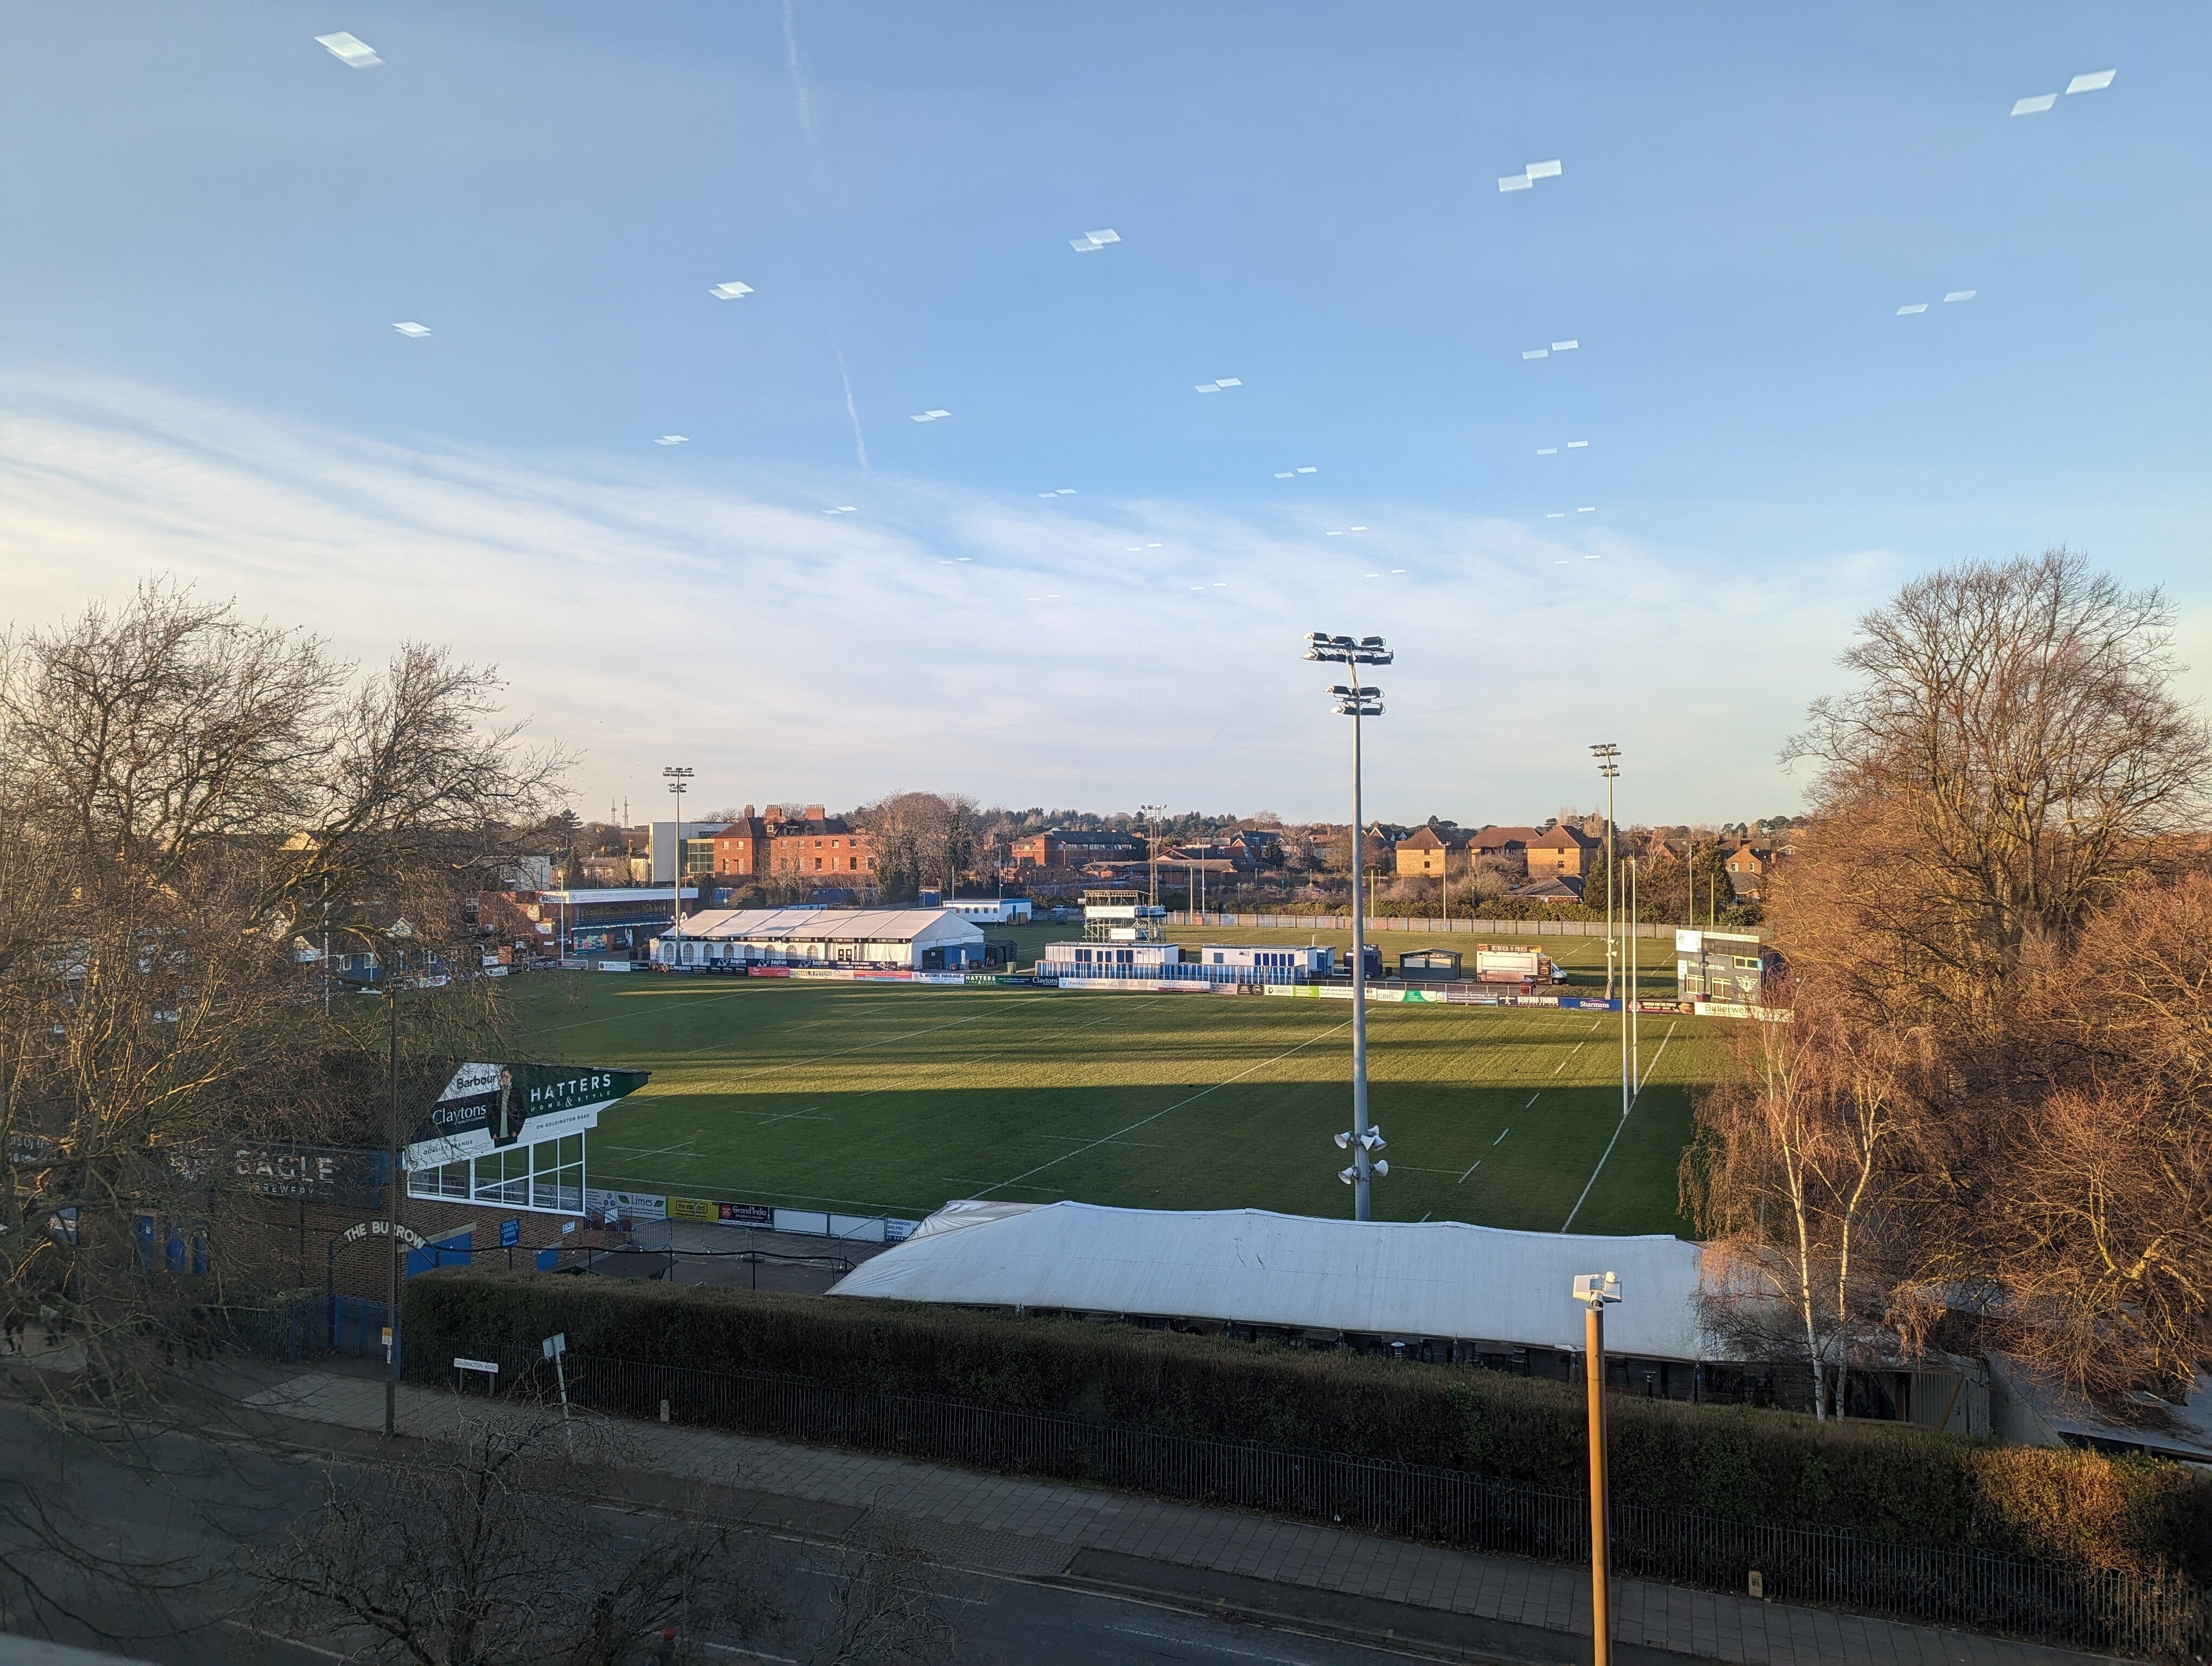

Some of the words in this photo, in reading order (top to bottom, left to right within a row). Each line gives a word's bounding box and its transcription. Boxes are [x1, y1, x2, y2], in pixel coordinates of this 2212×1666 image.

[1032, 977, 1058, 985] Claytons
[456, 1075, 497, 1089] Barbour
[531, 1073, 611, 1103] HATTERS
[531, 1101, 561, 1112] HOME
[565, 1096, 574, 1107] &
[577, 1091, 610, 1102] STYLE
[432, 1104, 486, 1126] Claytons
[545, 1117, 576, 1127] GOLDINGTON
[423, 1145, 448, 1155] QUALITY
[631, 1195, 653, 1207] Limes
[732, 1205, 752, 1215] Grand
[752, 1206, 767, 1216] India
[502, 1219, 517, 1228] TOILETS
[343, 1222, 367, 1242] THE
[501, 1226, 515, 1234] LADIES
[455, 1360, 483, 1369] GOLDINGTON
